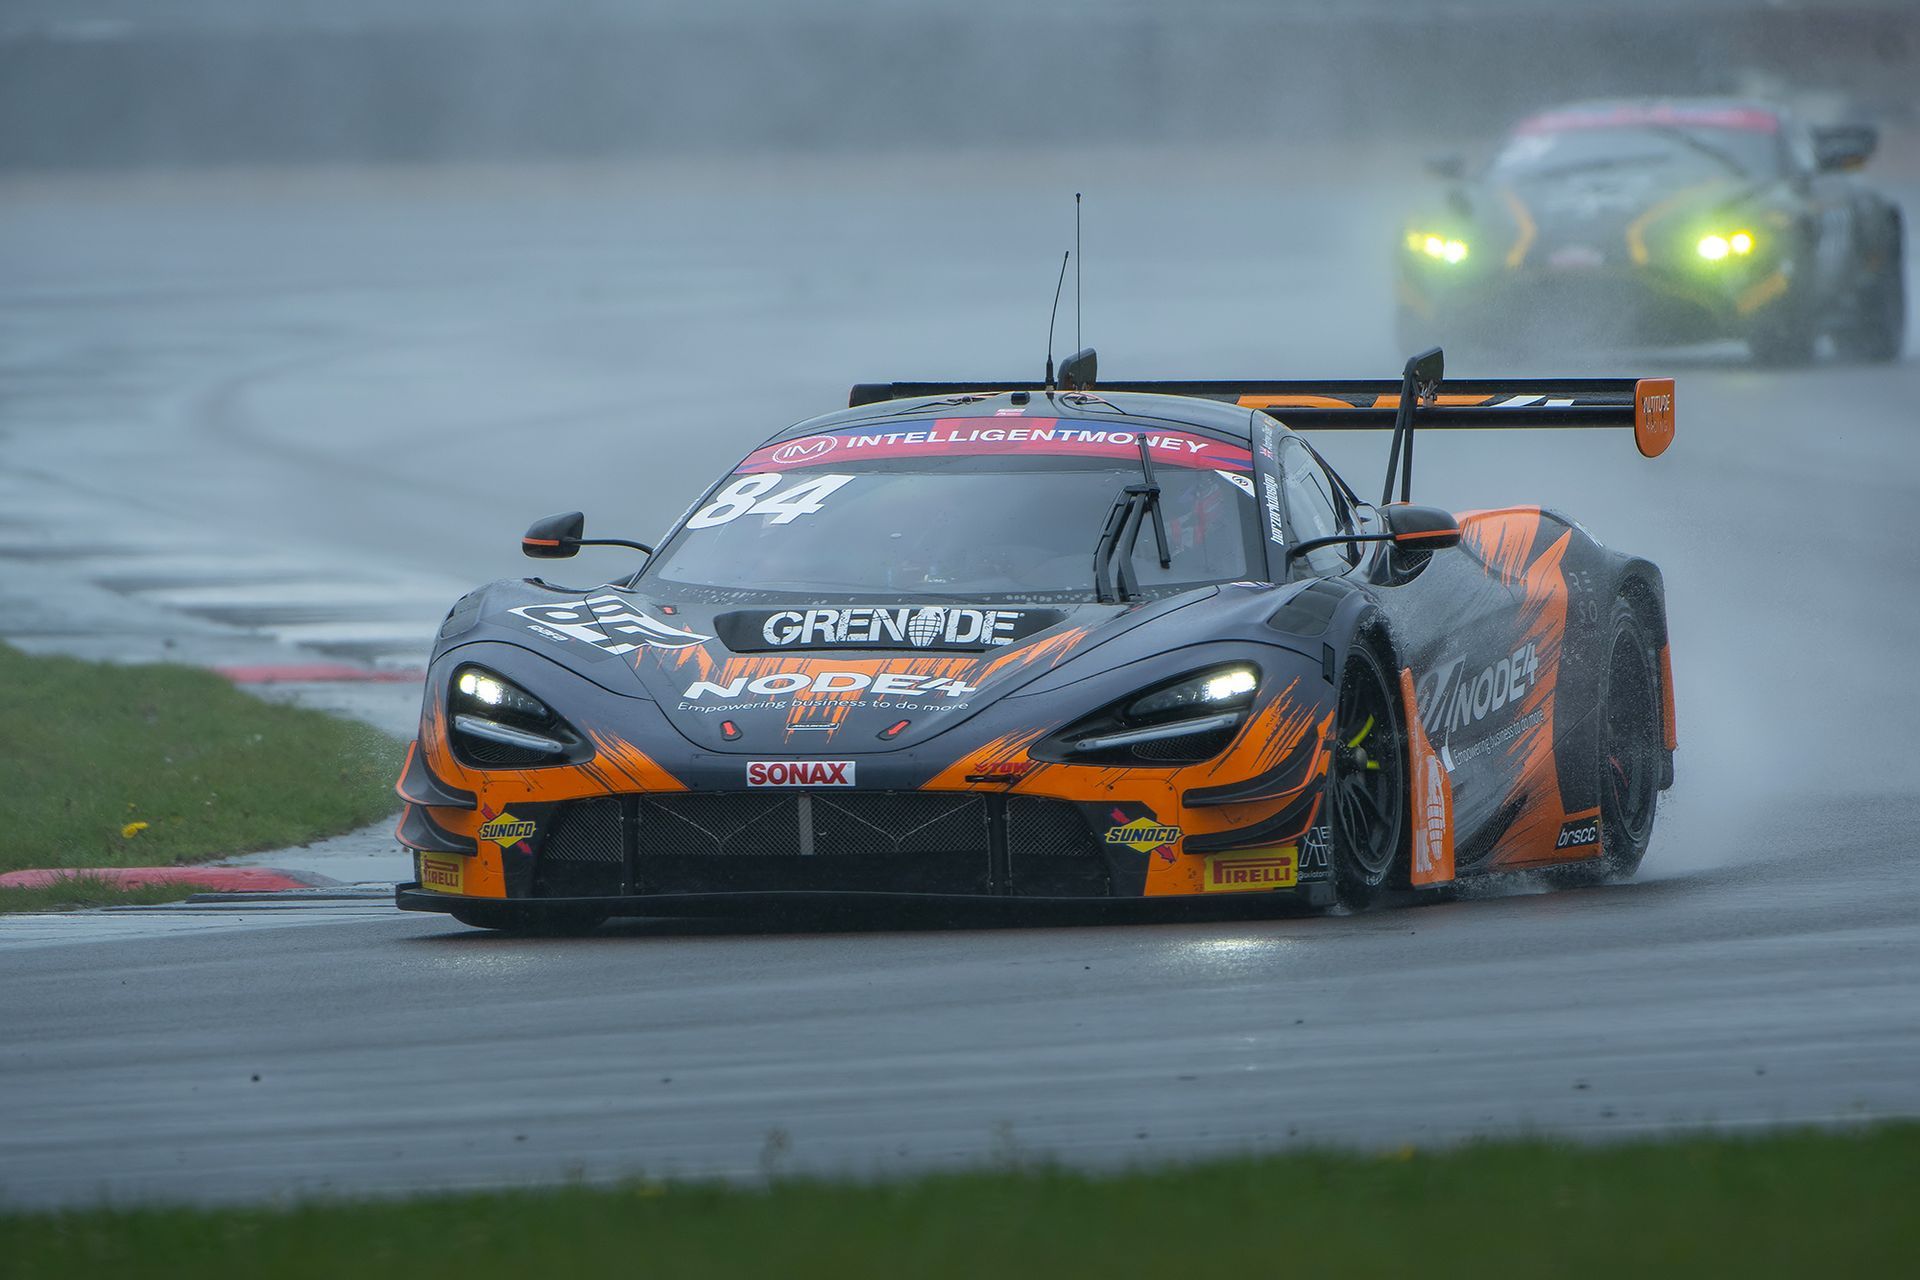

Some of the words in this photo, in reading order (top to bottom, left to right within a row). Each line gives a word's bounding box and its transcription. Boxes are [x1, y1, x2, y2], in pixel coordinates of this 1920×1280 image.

[686, 473, 856, 529] 84
[683, 672, 976, 699] NODE4
[1452, 642, 1538, 733] NODE4
[678, 701, 787, 713] Empowering
[792, 699, 866, 707] business
[896, 701, 918, 709] do
[923, 703, 969, 712] more
[1453, 738, 1491, 766] Empowering
[749, 763, 849, 785] SONAX
[482, 823, 534, 838] SUNOCO
[1109, 828, 1178, 842] SUNOCO
[1558, 827, 1596, 846] brscc
[424, 859, 459, 888] PIRELLI
[1213, 857, 1292, 885] PIRELLI
